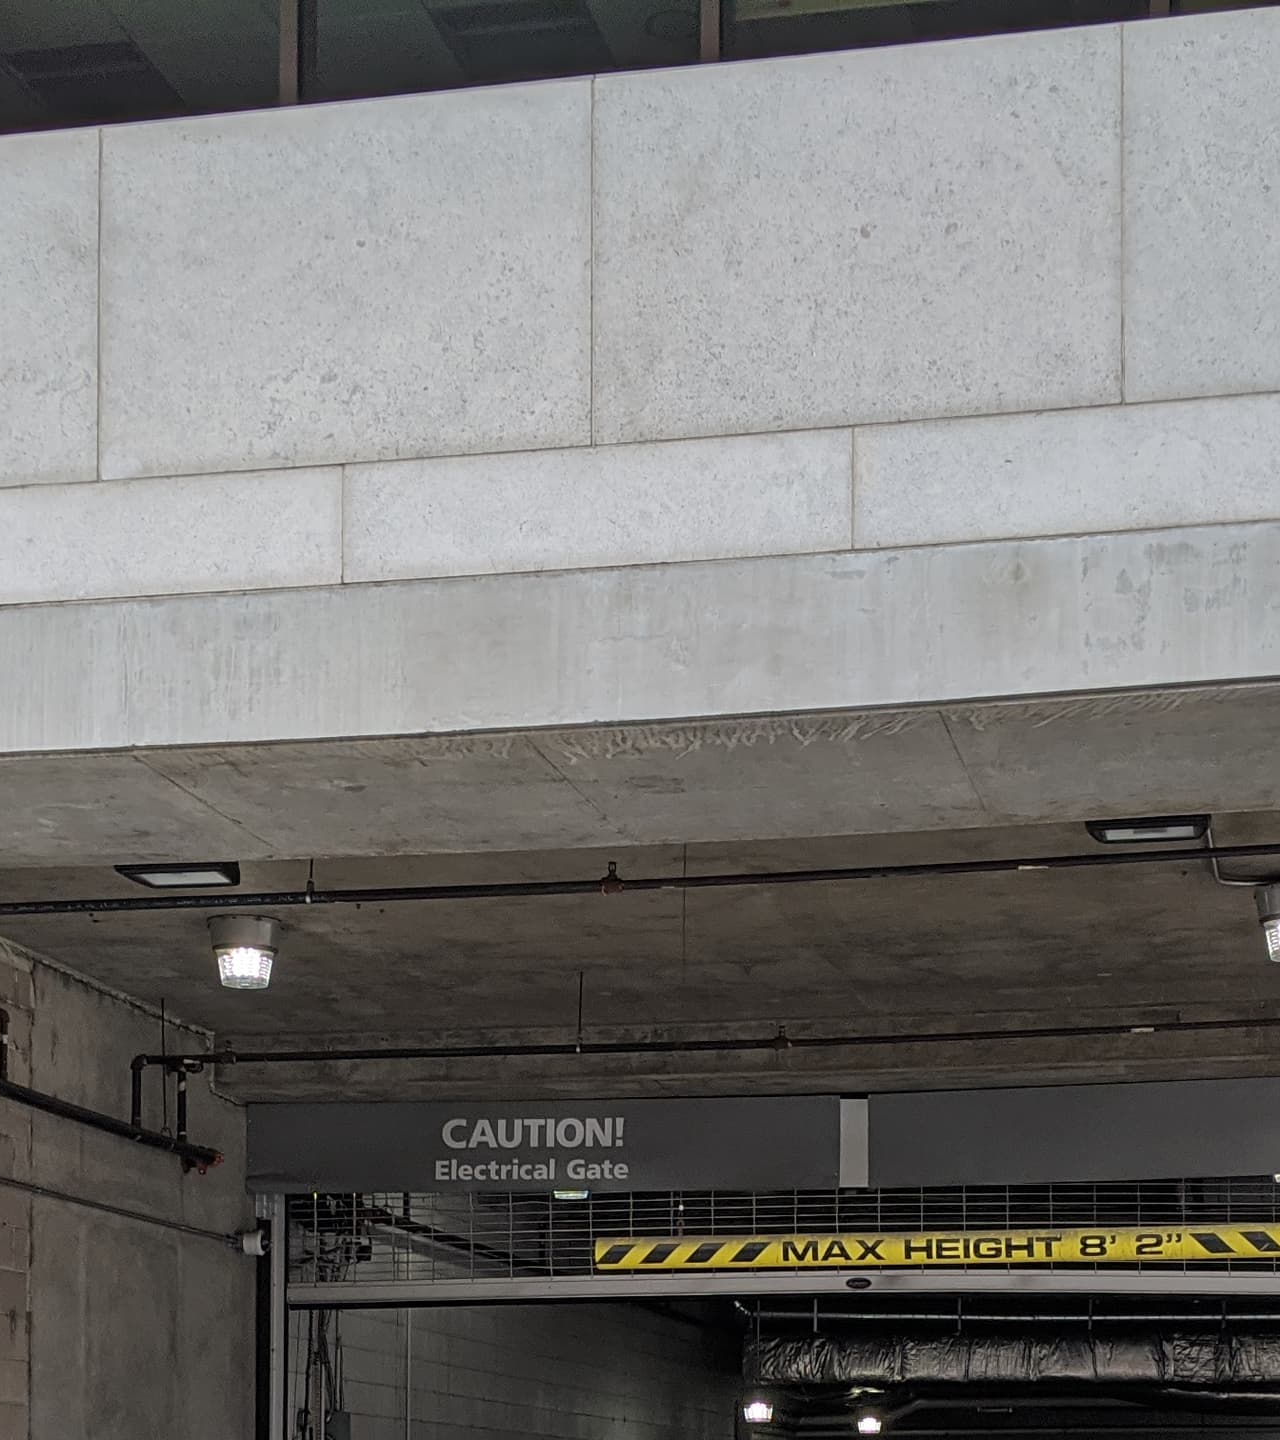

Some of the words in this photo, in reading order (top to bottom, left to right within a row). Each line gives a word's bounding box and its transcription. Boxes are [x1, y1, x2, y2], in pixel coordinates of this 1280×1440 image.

[441, 1117, 625, 1149] CAUTION!
[434, 1158, 556, 1181] Electrical
[566, 1158, 629, 1180] Gate
[782, 1239, 885, 1262] MAX
[904, 1235, 1062, 1260] HEIGHT
